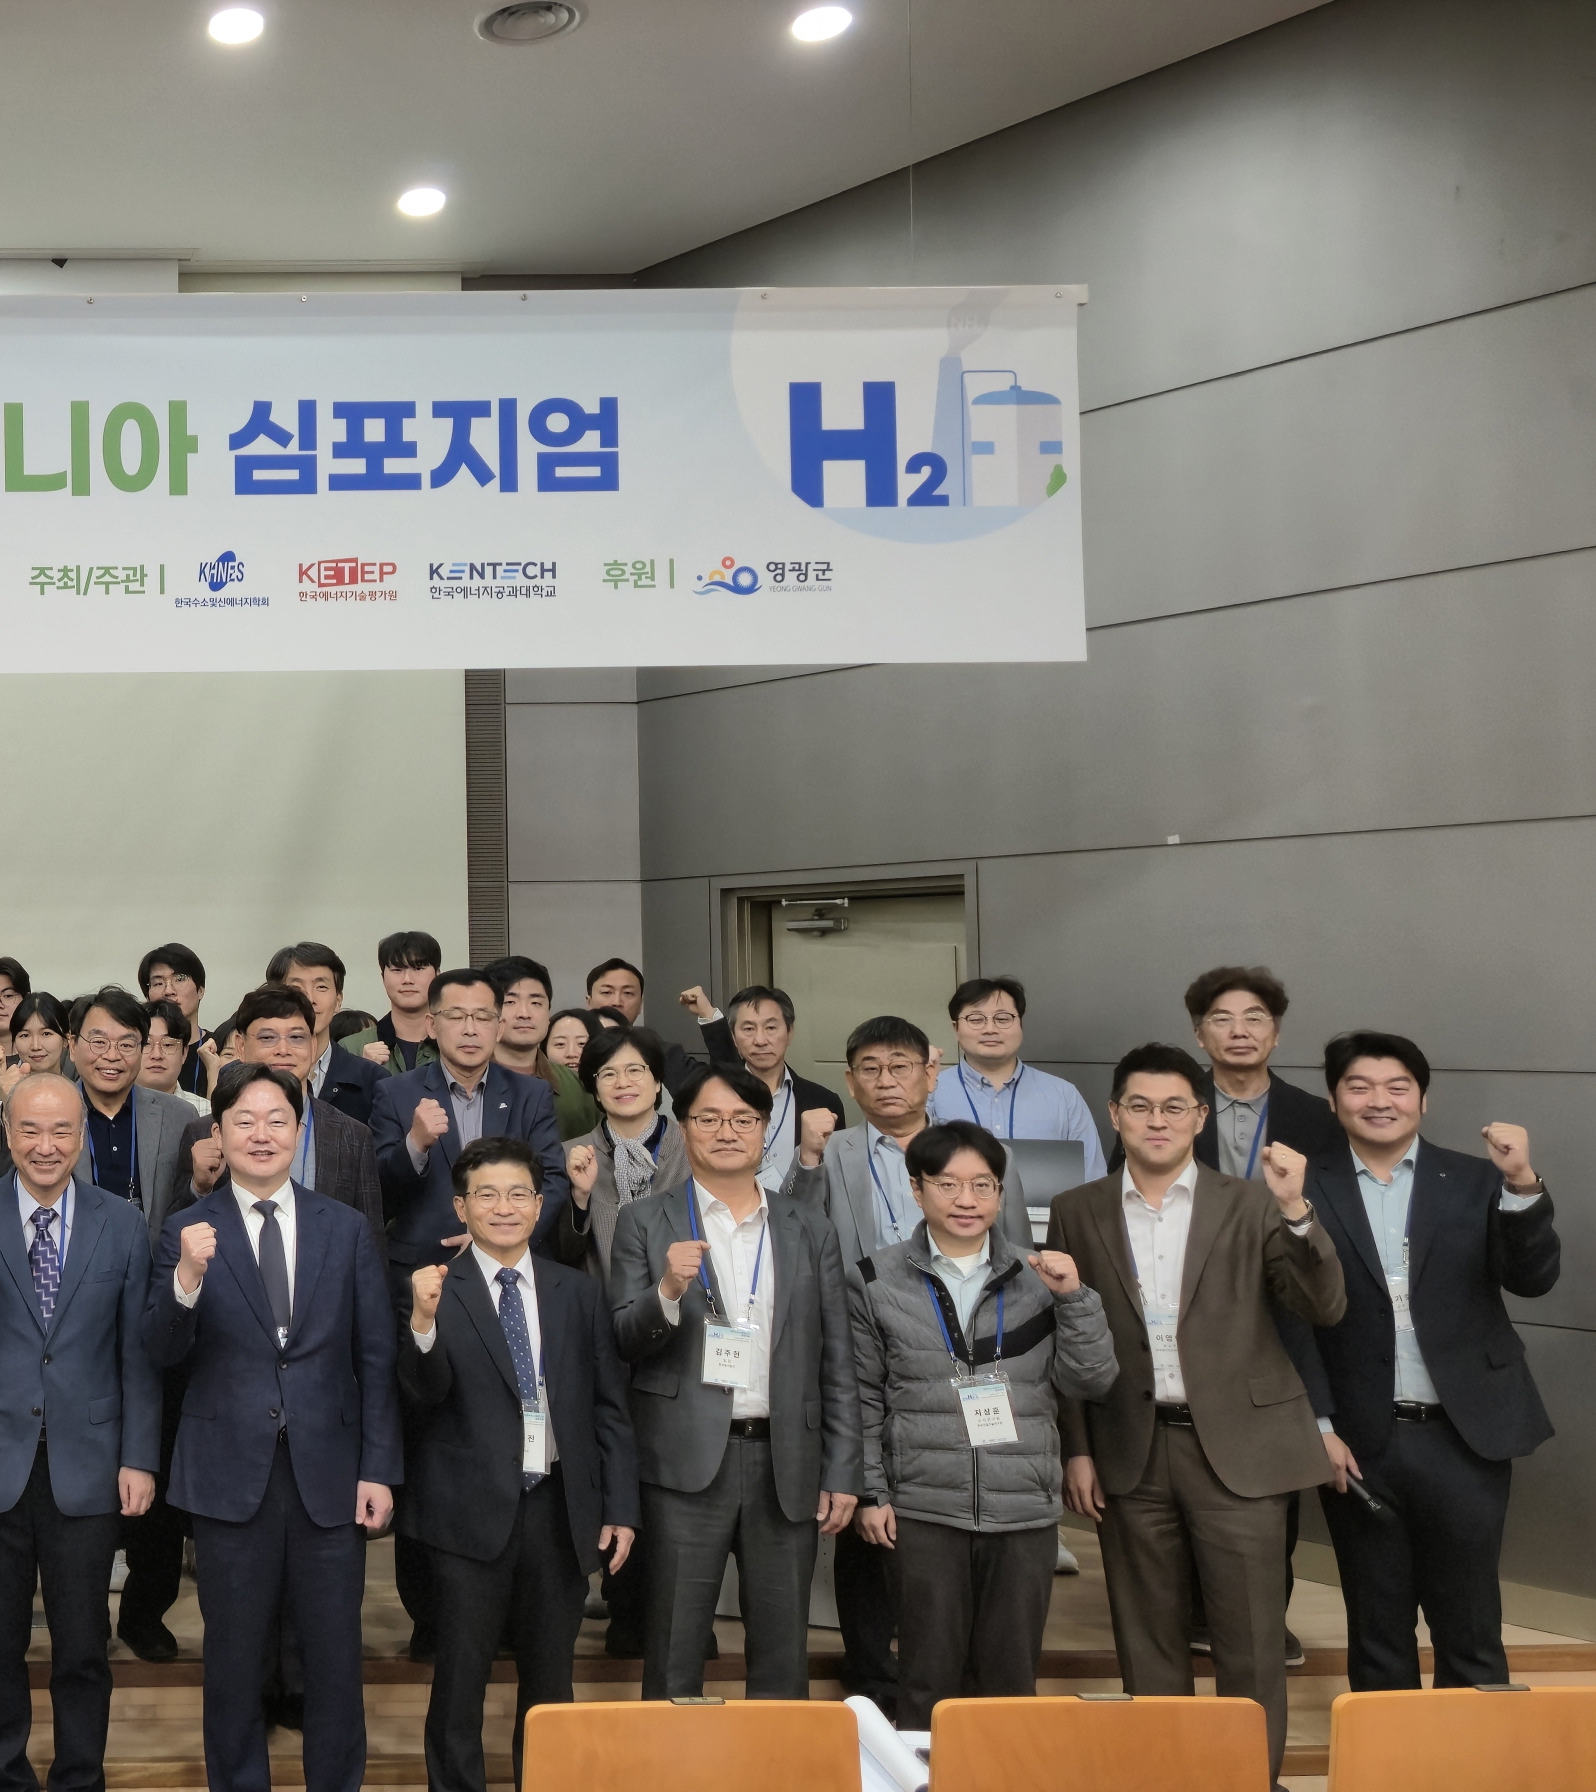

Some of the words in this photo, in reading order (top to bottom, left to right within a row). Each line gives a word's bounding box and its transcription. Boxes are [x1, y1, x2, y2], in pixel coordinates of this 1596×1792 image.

[229, 397, 619, 495] 심포지엄
[28, 564, 149, 596] 주최/주관
[298, 557, 398, 588] KETEP
[429, 561, 557, 581] KENTECH
[602, 559, 657, 590] 후원
[765, 561, 834, 583] 영광군
[174, 596, 270, 608] 한국수소및신에너지학회
[298, 589, 398, 602] 한국에너지기술평가원
[429, 584, 557, 600] 한국에너지공과대학교
